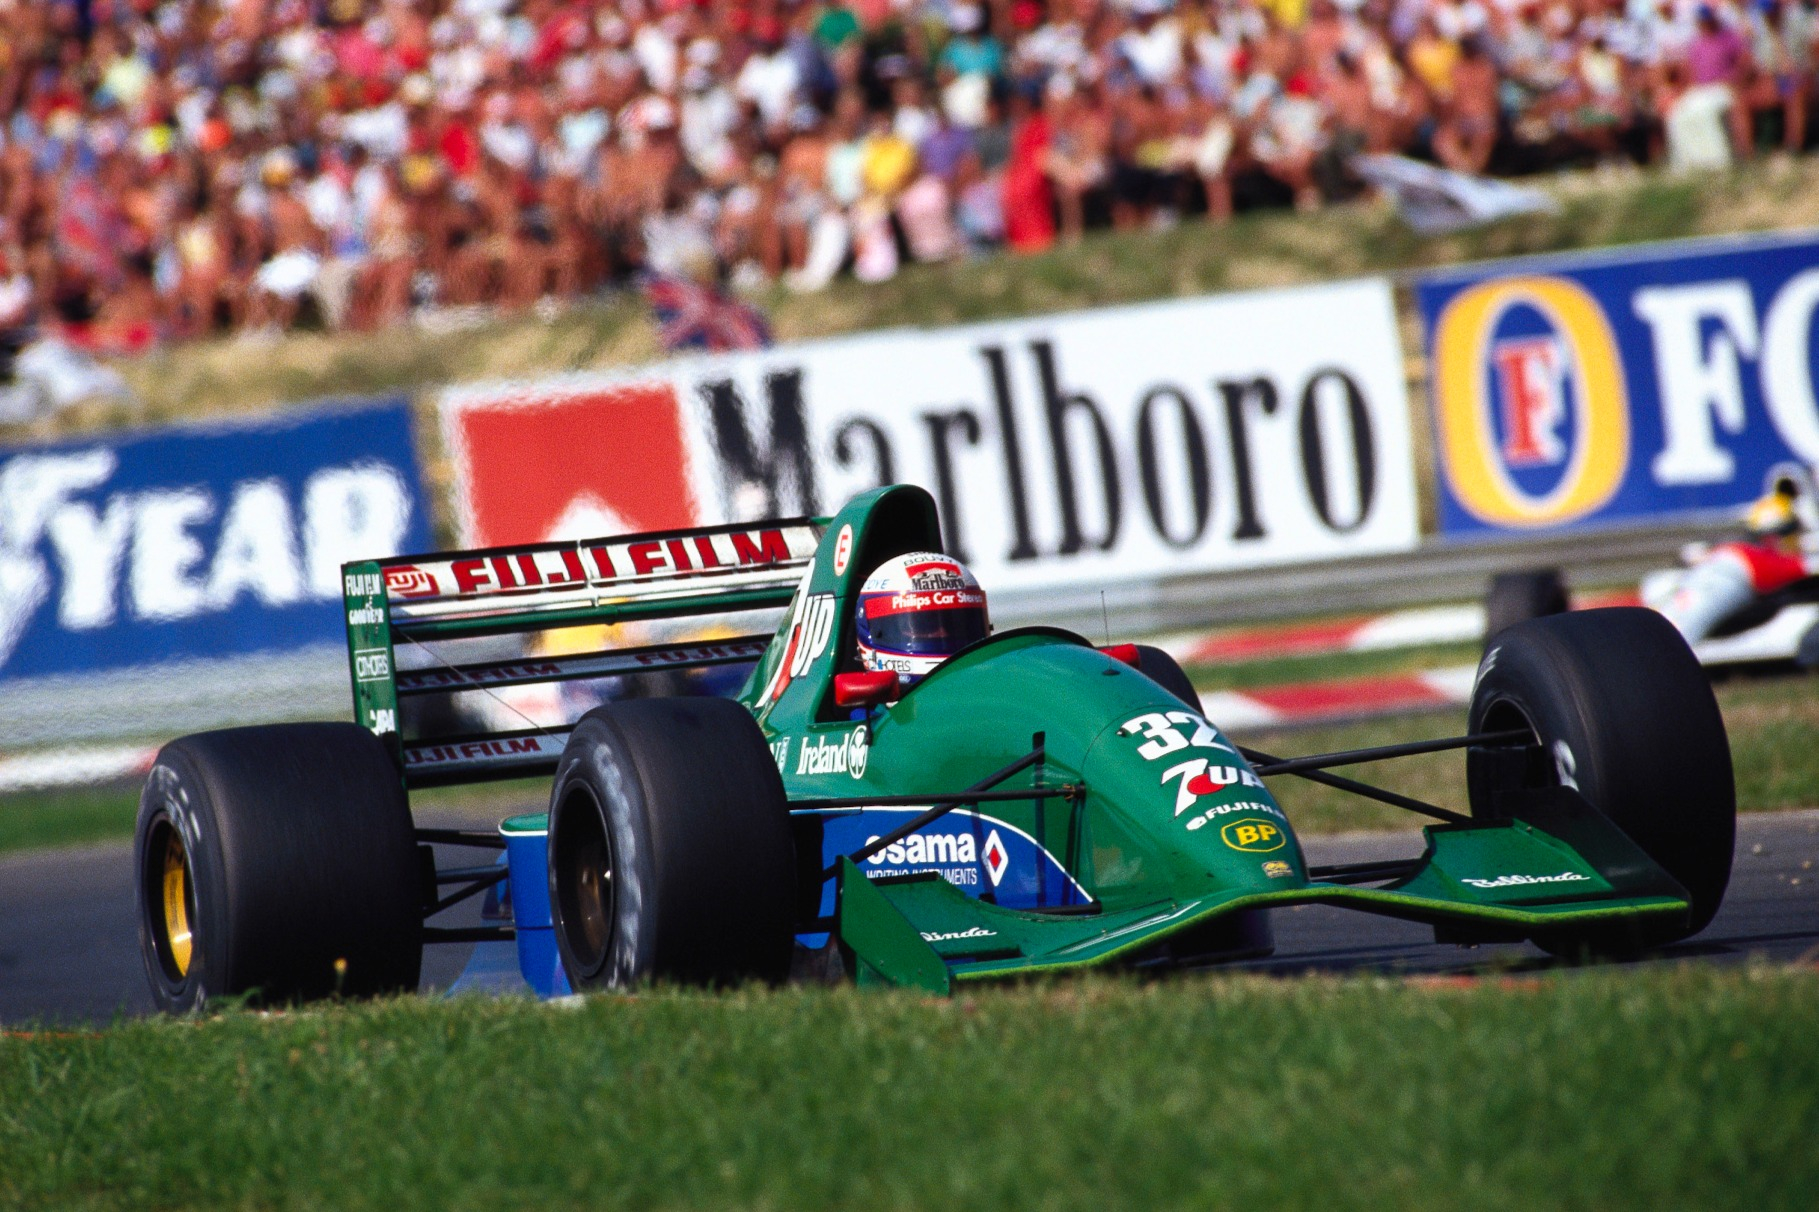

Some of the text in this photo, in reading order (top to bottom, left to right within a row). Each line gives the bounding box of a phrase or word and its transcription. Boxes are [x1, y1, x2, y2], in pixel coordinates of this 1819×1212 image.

[699, 341, 1378, 566] Marlboro
[451, 529, 791, 593] FUJIFILM
[892, 590, 931, 610] Philips
[932, 592, 956, 605] Car
[911, 574, 966, 592] Marlboro
[398, 662, 562, 688] UJIFILM
[405, 738, 542, 764] UJIFILM
[1119, 711, 1237, 761] 32
[796, 732, 849, 775] Ireland
[1161, 758, 1266, 818] 7UP
[1235, 824, 1277, 846] BP
